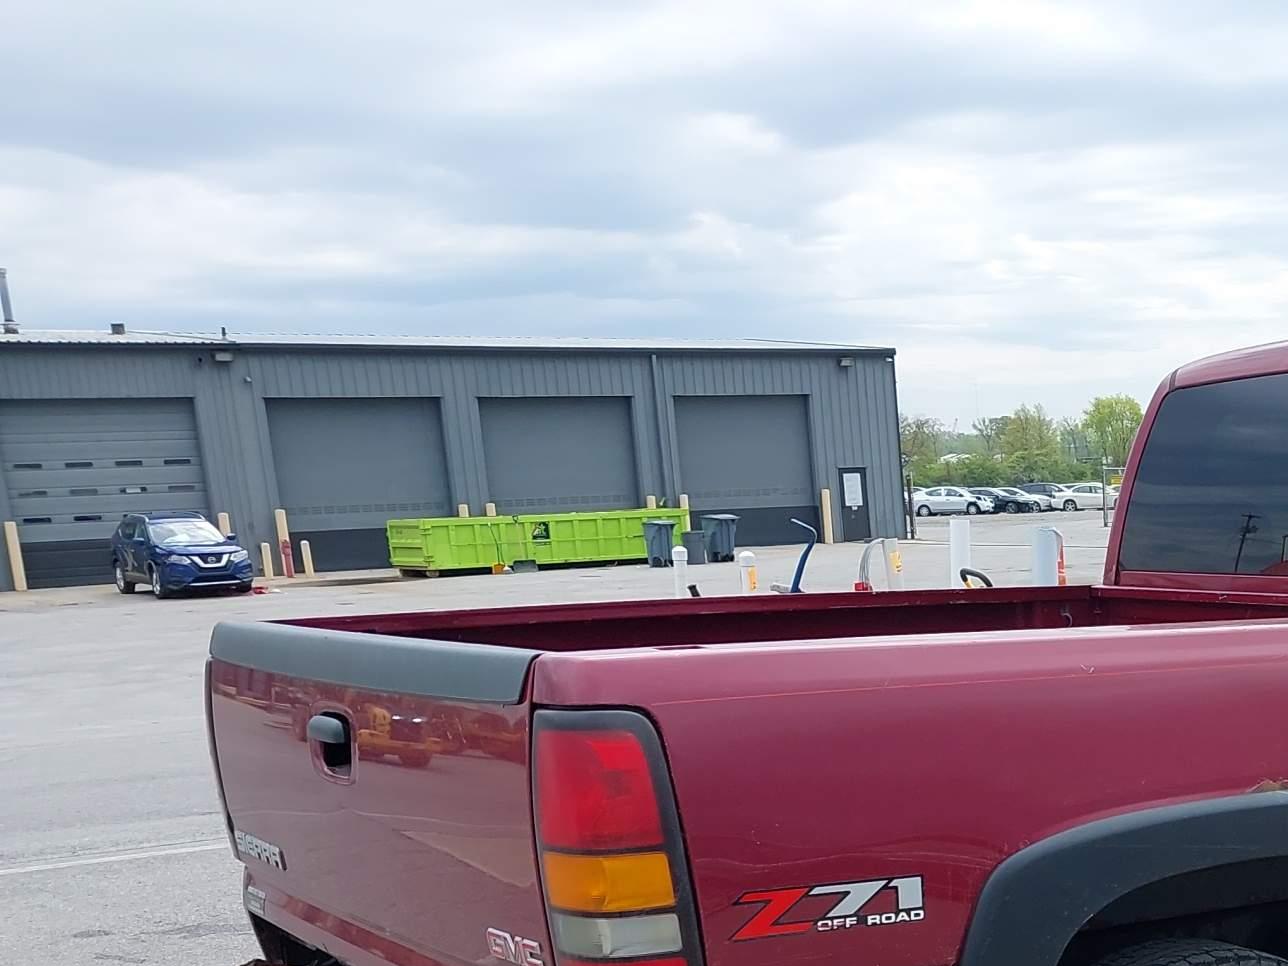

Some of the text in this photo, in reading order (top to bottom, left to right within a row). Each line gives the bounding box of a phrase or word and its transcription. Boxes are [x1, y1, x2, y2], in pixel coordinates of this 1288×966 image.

[236, 829, 282, 870] SIERRA
[731, 875, 924, 942] Z71
[816, 909, 925, 932] OFF ROAD
